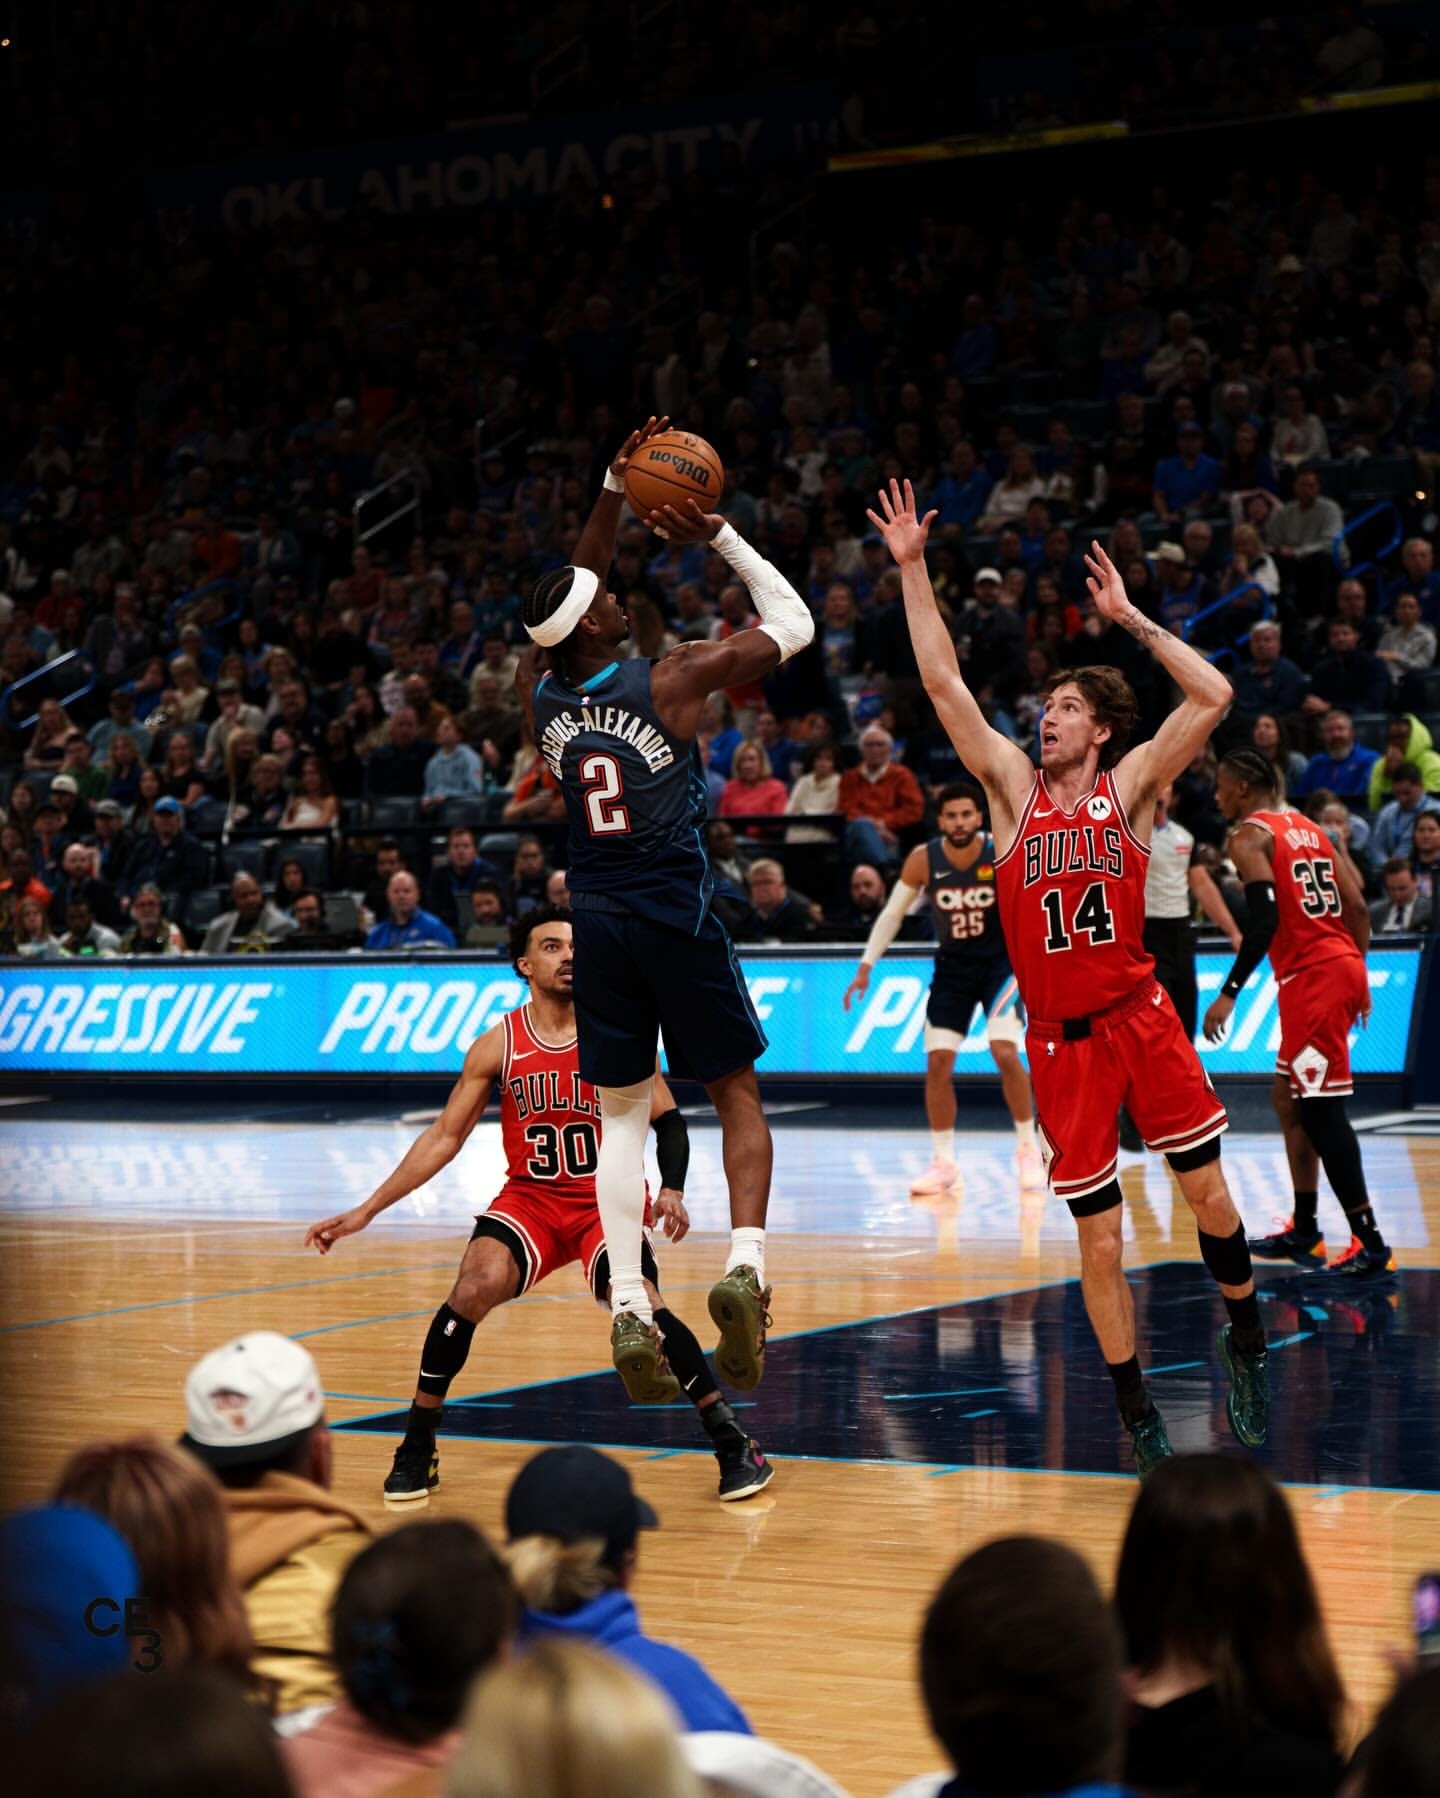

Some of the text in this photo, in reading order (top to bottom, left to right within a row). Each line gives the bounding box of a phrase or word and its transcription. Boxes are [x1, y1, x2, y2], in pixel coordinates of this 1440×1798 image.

[220, 141, 601, 233] OKLAHOMA
[603, 117, 765, 184] CITY
[649, 450, 710, 488] Wilson
[578, 752, 632, 837] 2
[1024, 826, 1122, 888] BULLS
[935, 886, 995, 911] OKC
[1041, 881, 1116, 954] 14
[1292, 858, 1342, 919] 35
[951, 911, 985, 939] 25
[0, 983, 273, 1054] GRESSIVE
[524, 1122, 599, 1179] 30
